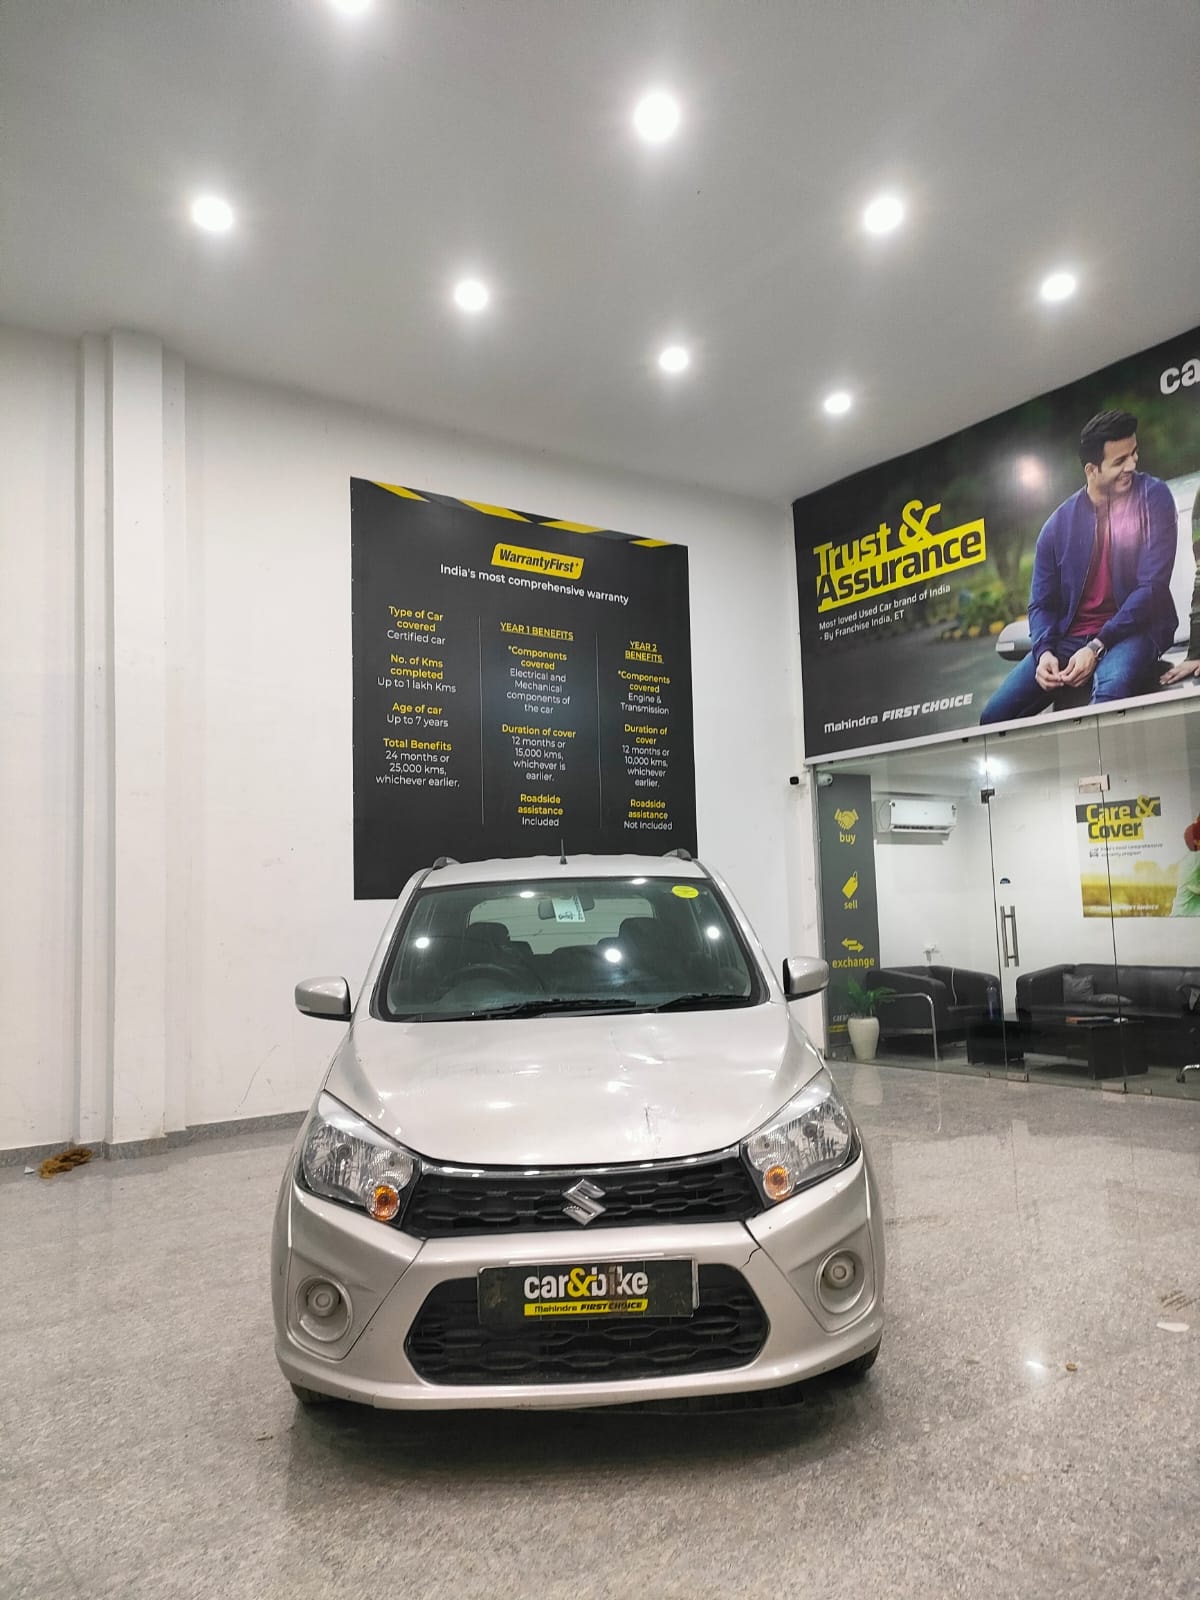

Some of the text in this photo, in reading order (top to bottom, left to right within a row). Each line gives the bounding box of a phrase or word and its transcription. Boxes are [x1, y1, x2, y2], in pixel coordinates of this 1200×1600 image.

[814, 500, 942, 577] Trust &
[817, 530, 982, 602] Assurance
[440, 563, 629, 606] India's most comprehensive warranty
[388, 605, 444, 621] Type of Car
[819, 583, 950, 631] Most loved Used Car brand of India
[396, 620, 436, 632] covered
[500, 622, 525, 633] YEAR
[532, 626, 574, 641] BENEFITS
[824, 630, 834, 642] By
[835, 621, 870, 637] Franchise
[871, 616, 893, 628] India,
[894, 610, 905, 621] ET
[386, 630, 445, 645] Certified car
[630, 640, 657, 652] YEAR 2
[390, 654, 443, 668] No. of Kms
[625, 650, 663, 664] BENEFITS
[520, 660, 555, 670] covered
[390, 667, 443, 680] completed
[510, 668, 566, 682] Electrical and
[377, 676, 456, 693] Up to 1 lakh Kms
[514, 680, 562, 693] Mechanical
[629, 683, 660, 693] covered
[506, 691, 570, 705] components of
[628, 692, 655, 703] Engine
[392, 702, 442, 715] Age of car
[524, 704, 554, 714] the car
[620, 702, 669, 715] Transmission
[386, 714, 449, 728] Up to 7 years
[824, 715, 878, 734] Mahindra
[502, 724, 576, 738] Duration of cover
[624, 724, 668, 735] Duration of
[383, 738, 452, 751] Total Benefits
[512, 736, 566, 749] 12 months or
[635, 737, 657, 745] cover
[386, 750, 450, 763] 24 months or
[515, 747, 564, 760] 15,000 kms,
[622, 745, 630, 754] 12
[631, 746, 660, 756] months
[513, 759, 566, 771] whichever is
[624, 756, 649, 766] 10,000
[389, 763, 447, 775] 25,000 kms,
[627, 767, 666, 777] whichever
[376, 774, 426, 785] whichever
[520, 793, 561, 804] Roadside
[630, 799, 665, 809] Roadside
[518, 805, 564, 815] assistance
[628, 810, 668, 820] assistance
[1086, 795, 1159, 823] Care &
[522, 816, 560, 826] Included
[623, 821, 673, 831] Not Included
[1088, 822, 1142, 839] Cover
[840, 831, 856, 845] buy
[844, 900, 858, 910] sell
[832, 956, 875, 969] exchange
[524, 1265, 649, 1299] car&bike
[534, 1305, 578, 1313] Mahindra
